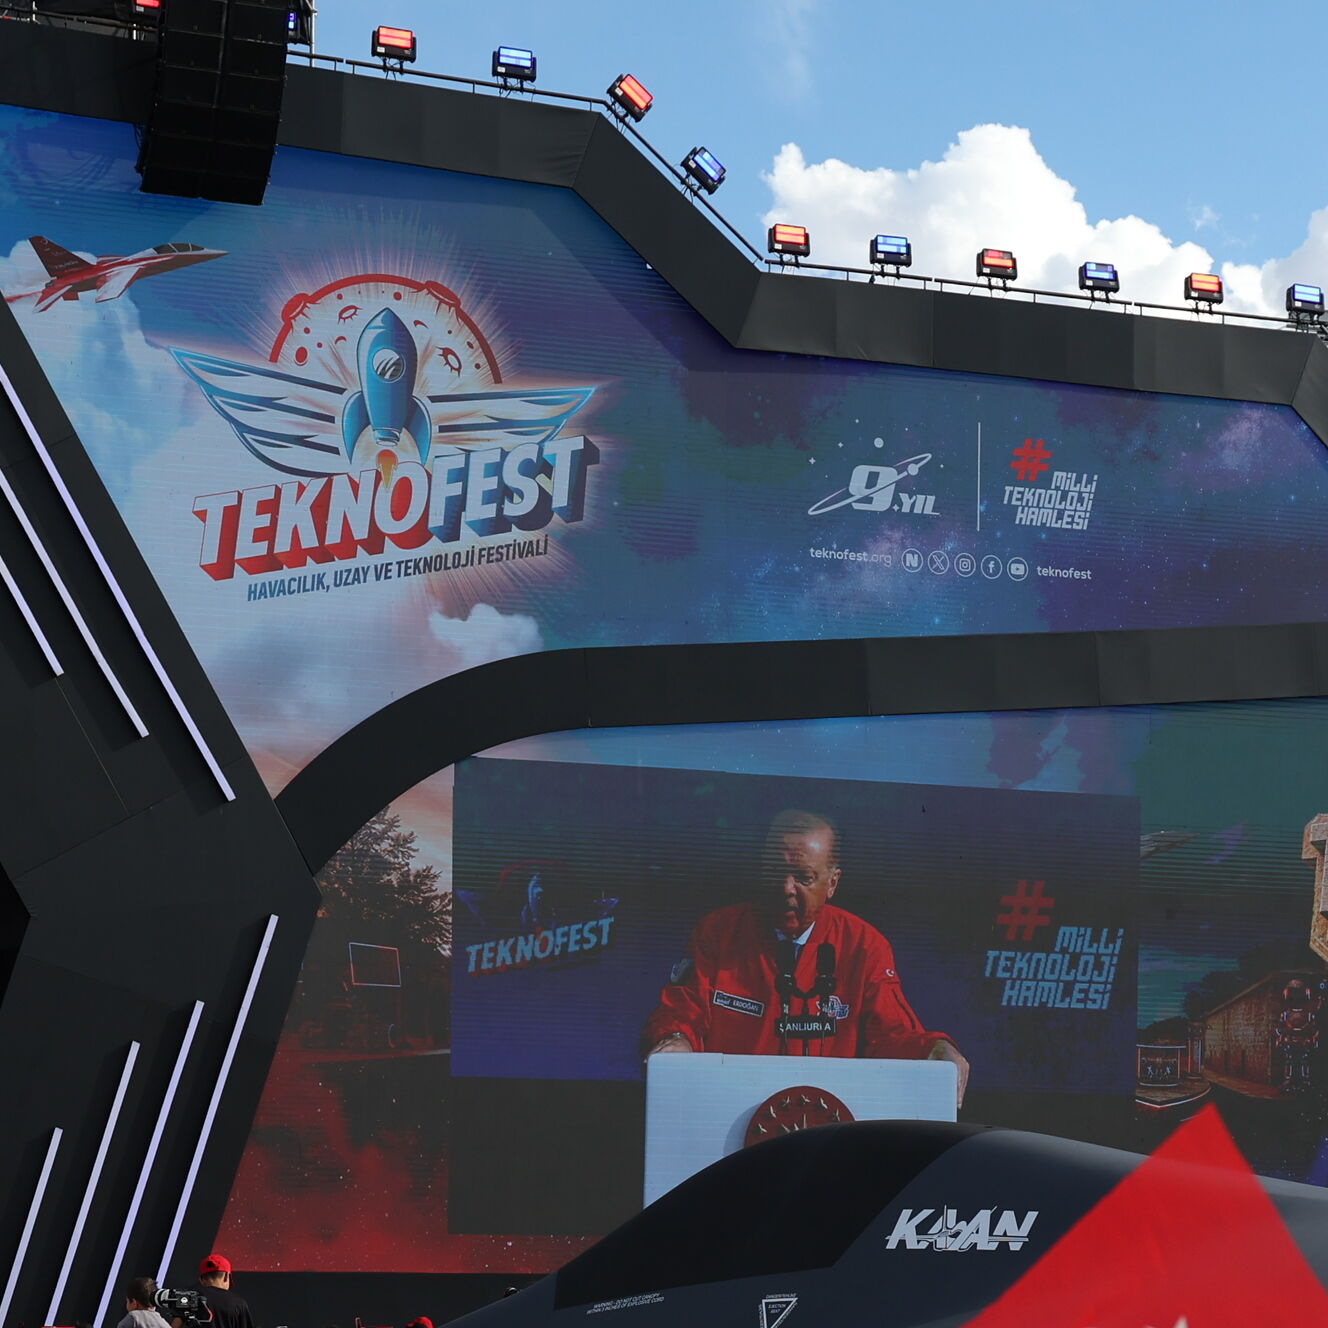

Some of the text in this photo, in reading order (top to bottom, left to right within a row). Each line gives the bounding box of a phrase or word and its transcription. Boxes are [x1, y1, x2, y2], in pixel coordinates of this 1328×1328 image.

[193, 435, 600, 581] TEKNOFEST
[247, 534, 549, 602] HAVACILIK, UZAY VE TEKNOLOJİ FESTİVALİ
[809, 547, 892, 567] teknofest.org
[1037, 565, 1092, 580] teknofest
[465, 916, 615, 975] TEKNOFEST
[885, 1205, 1039, 1252] KAAN
